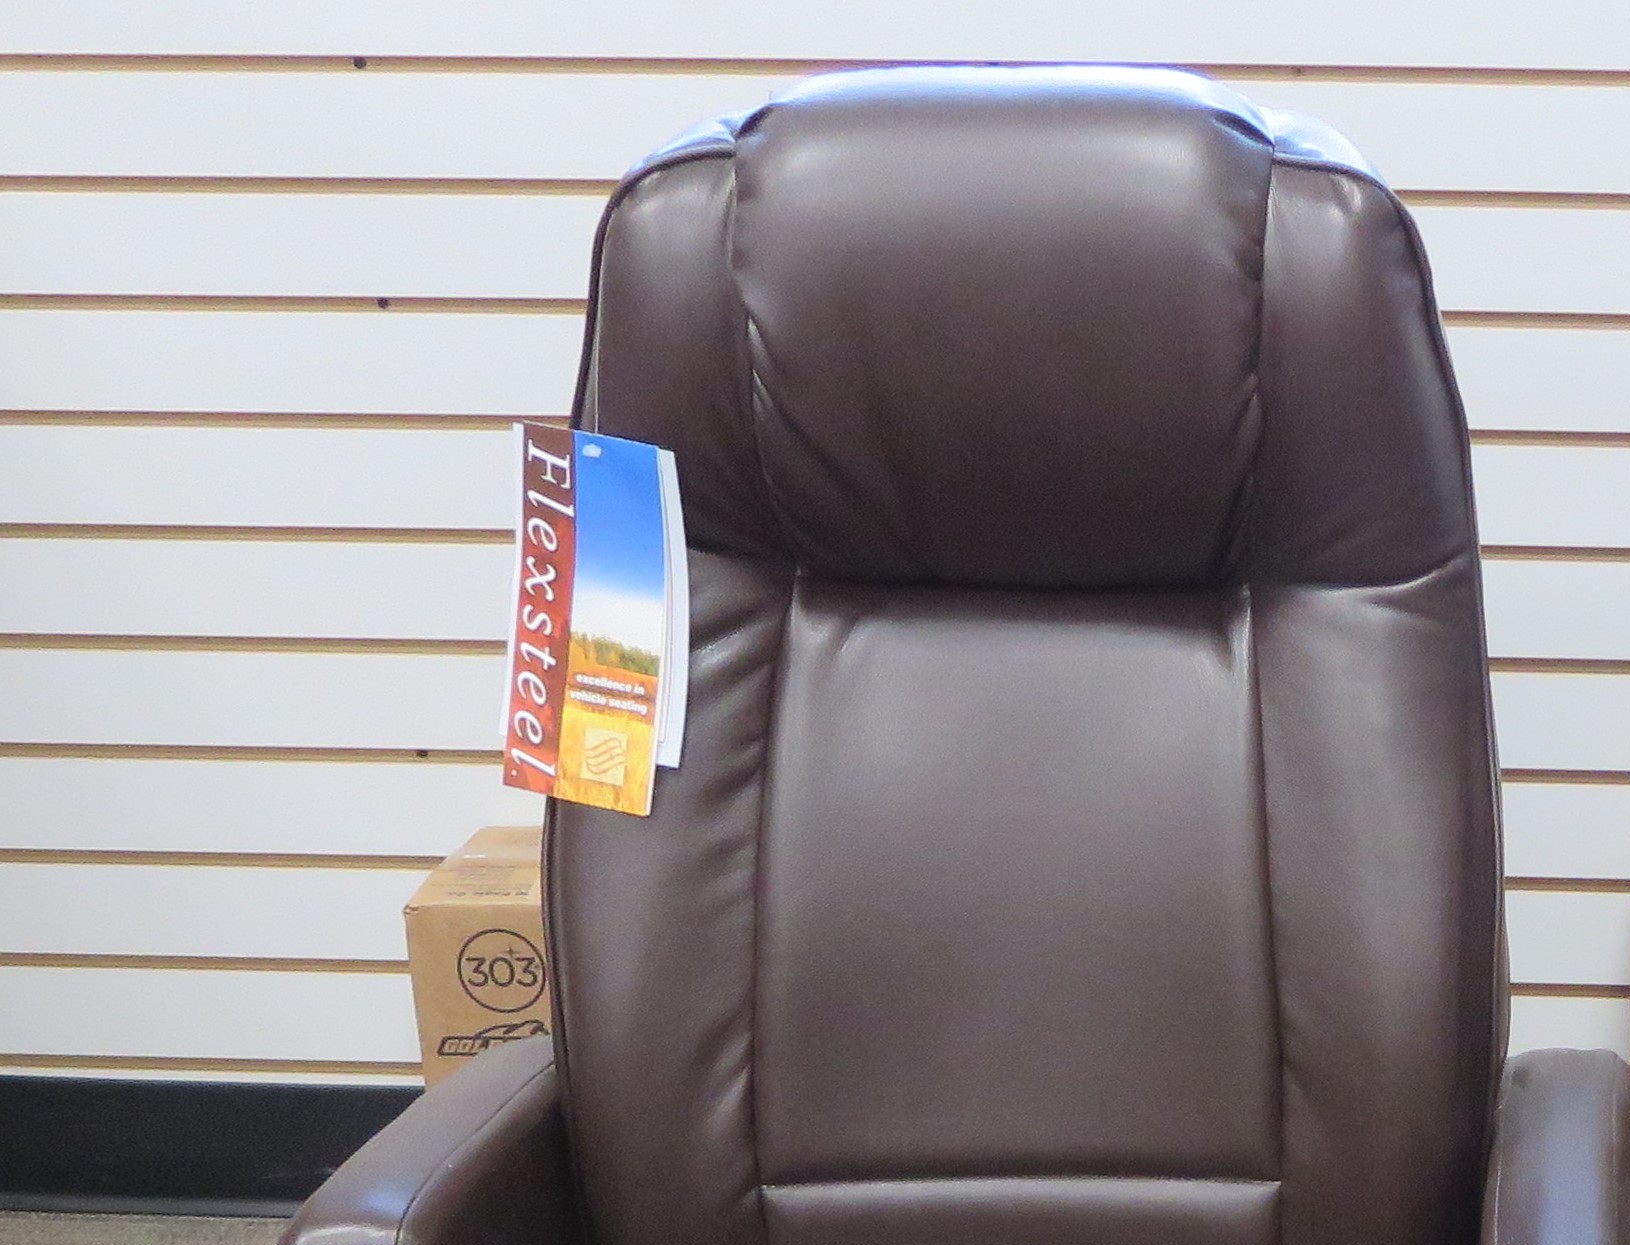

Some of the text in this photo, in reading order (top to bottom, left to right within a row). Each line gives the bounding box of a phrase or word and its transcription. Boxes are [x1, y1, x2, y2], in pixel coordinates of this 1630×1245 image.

[509, 438, 575, 777] Flexsteel
[575, 673, 645, 696] excellence in
[569, 690, 648, 716] vehicle seating
[465, 956, 538, 988] 303
